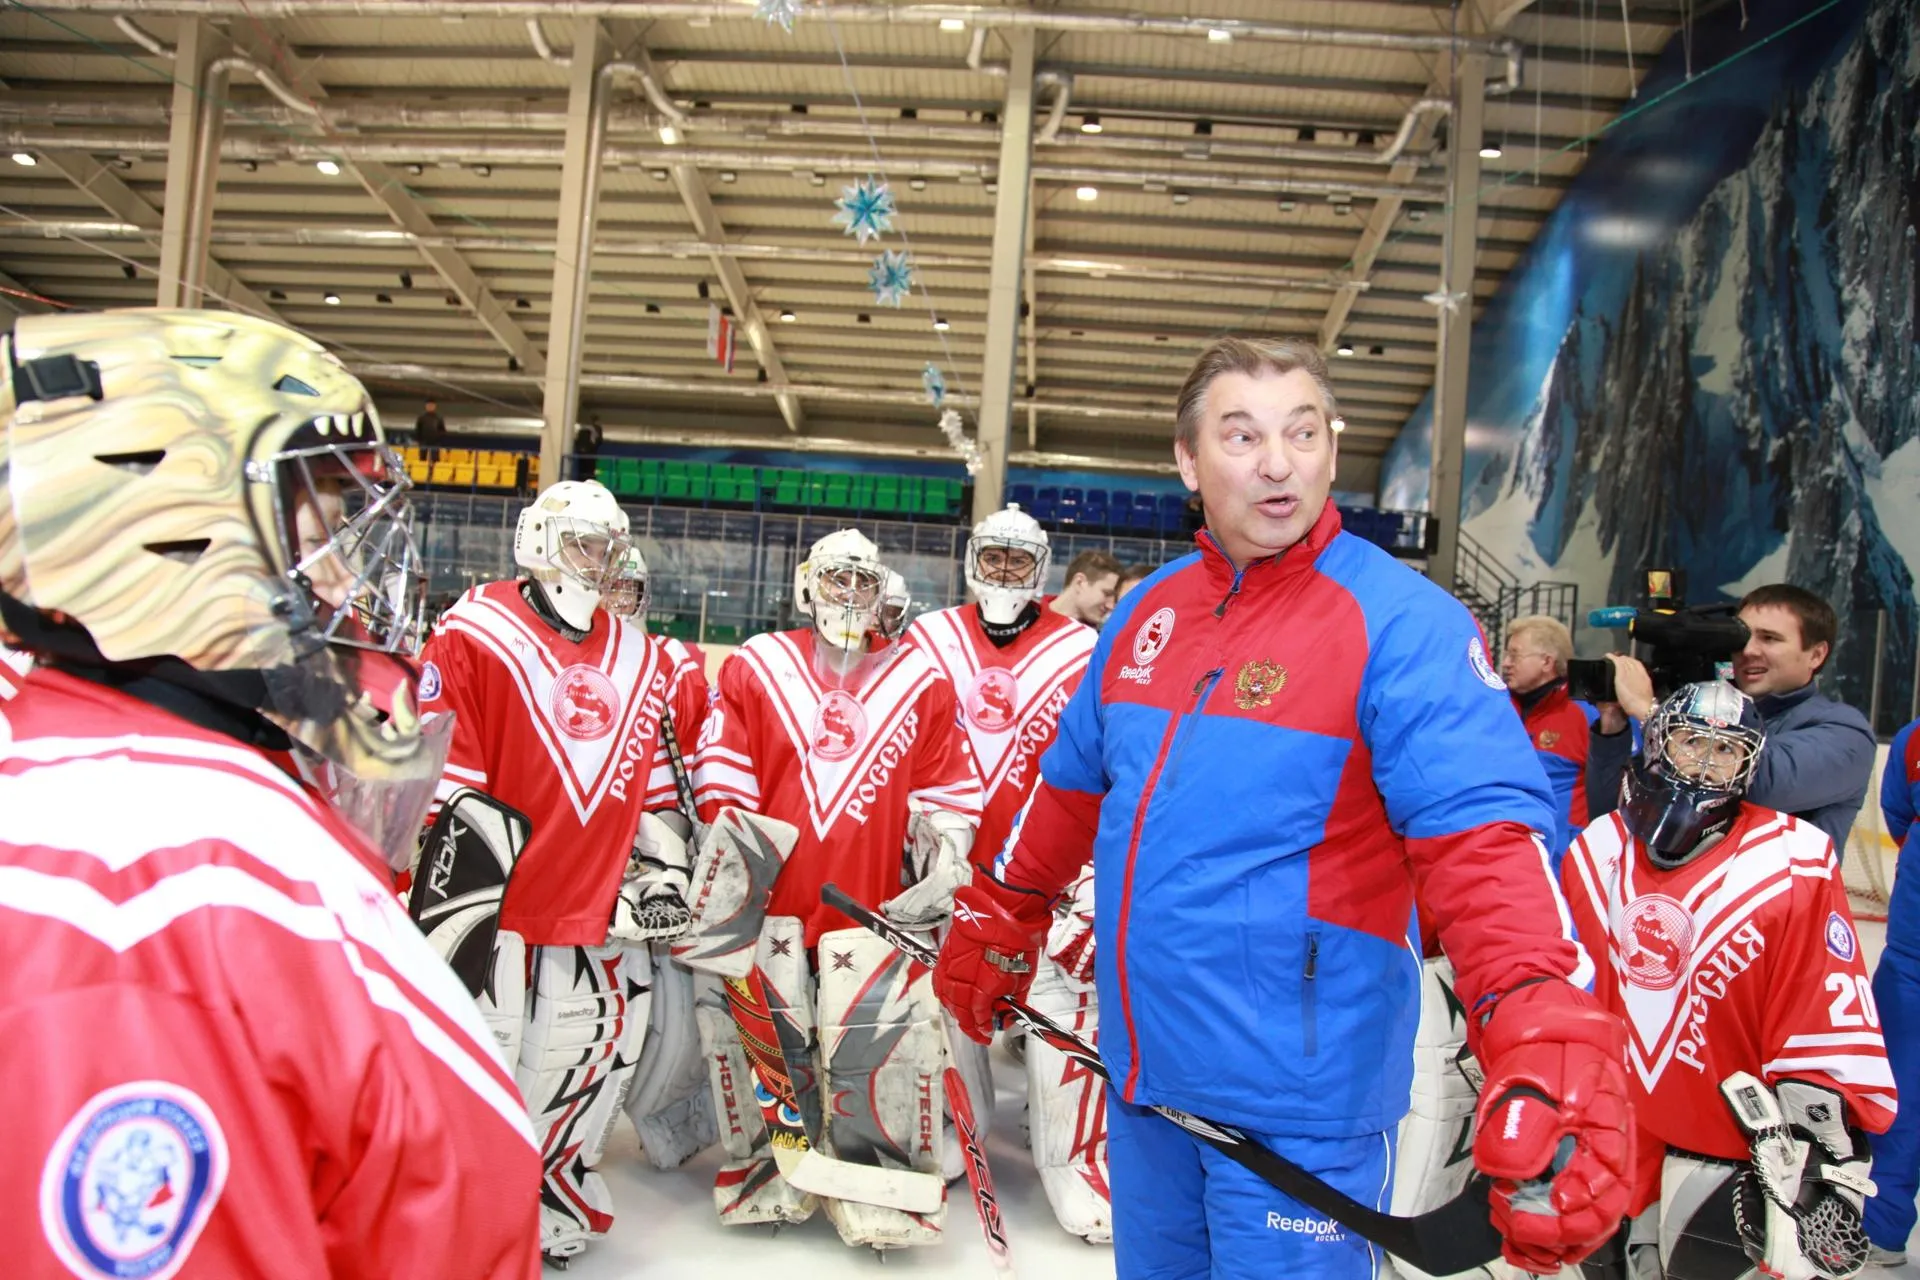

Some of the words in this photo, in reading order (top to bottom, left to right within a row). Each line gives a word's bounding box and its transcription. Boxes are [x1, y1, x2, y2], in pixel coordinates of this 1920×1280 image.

[610, 670, 667, 803] РОССИЯ
[697, 708, 724, 750] 20
[845, 710, 920, 826] РОССИЯ
[1006, 685, 1071, 792] РОССИЯ
[557, 1007, 596, 1020] Velocity
[1675, 919, 1765, 1074] РОССИЯ
[1825, 972, 1880, 1027] 20
[714, 1053, 742, 1137] ITECH
[919, 1073, 933, 1157] ITECH
[1267, 1211, 1338, 1234] Reebok
[1314, 1234, 1346, 1242] HOCKEY
